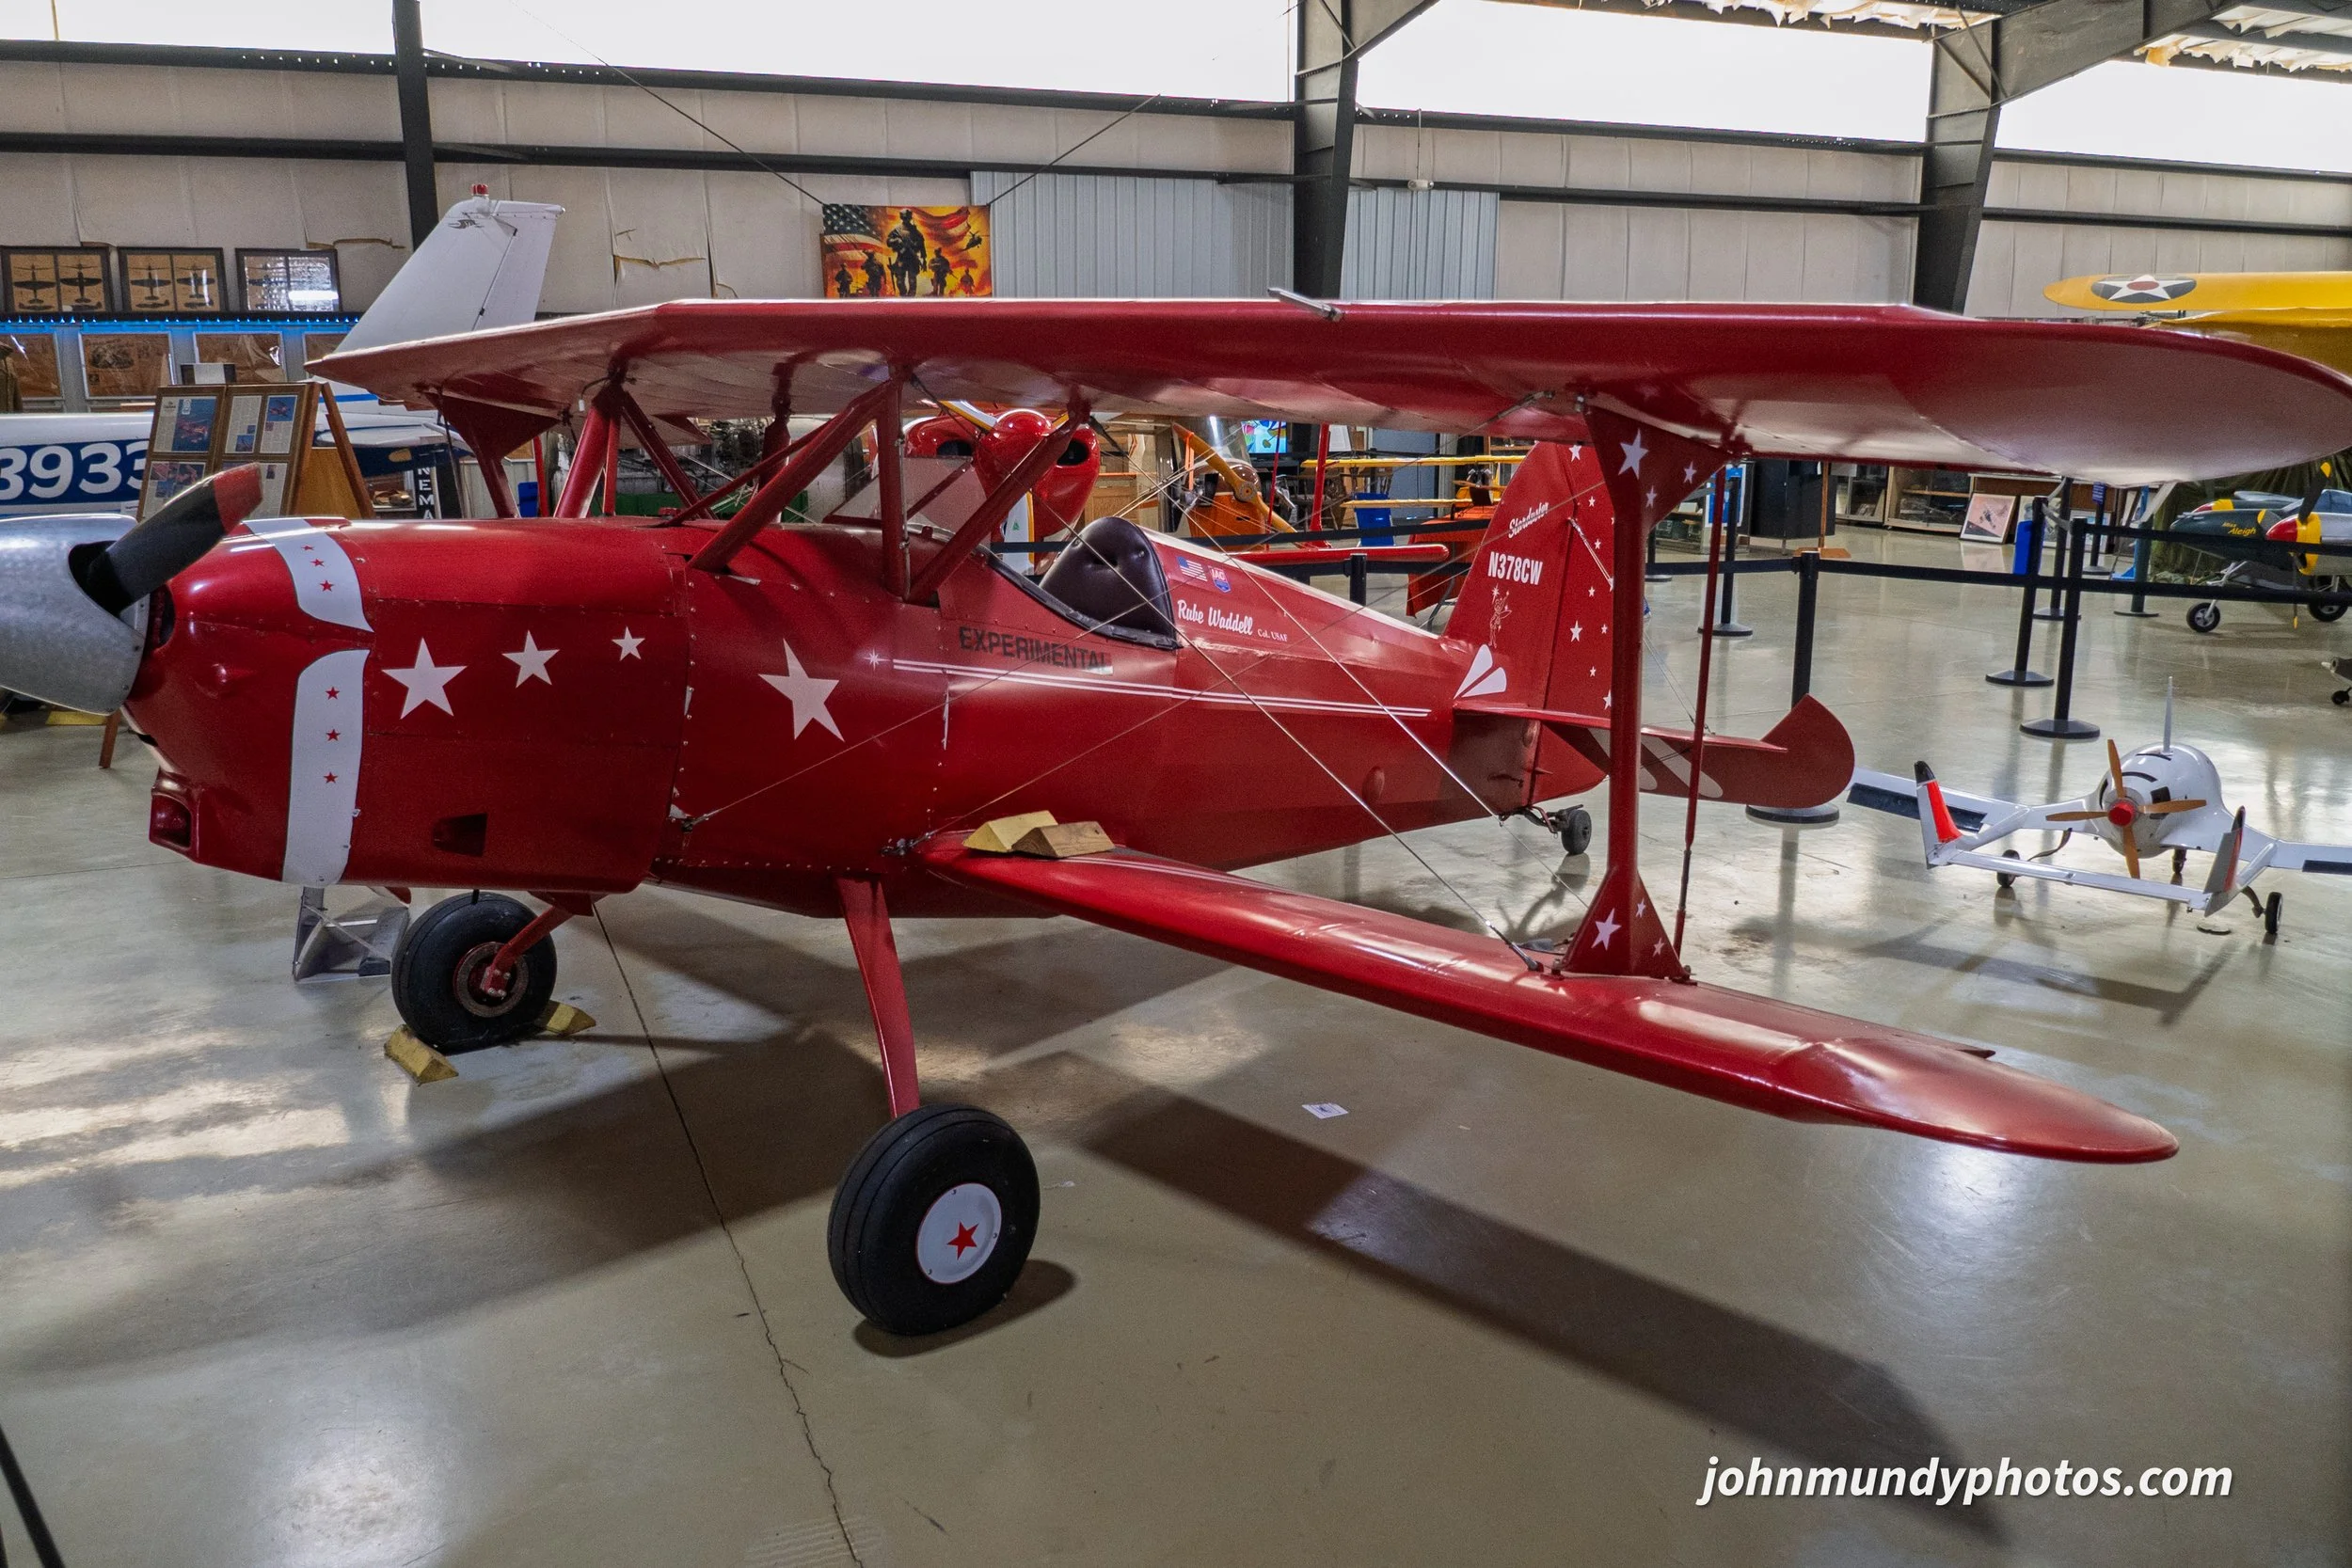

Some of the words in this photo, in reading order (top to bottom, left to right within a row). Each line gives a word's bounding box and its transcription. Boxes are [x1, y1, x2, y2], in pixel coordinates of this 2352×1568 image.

[1487, 551, 1543, 585] N378CW
[1177, 599, 1204, 625] Rube
[1208, 607, 1253, 636] Waddell
[959, 626, 1111, 670] EXPERIMENTAL
